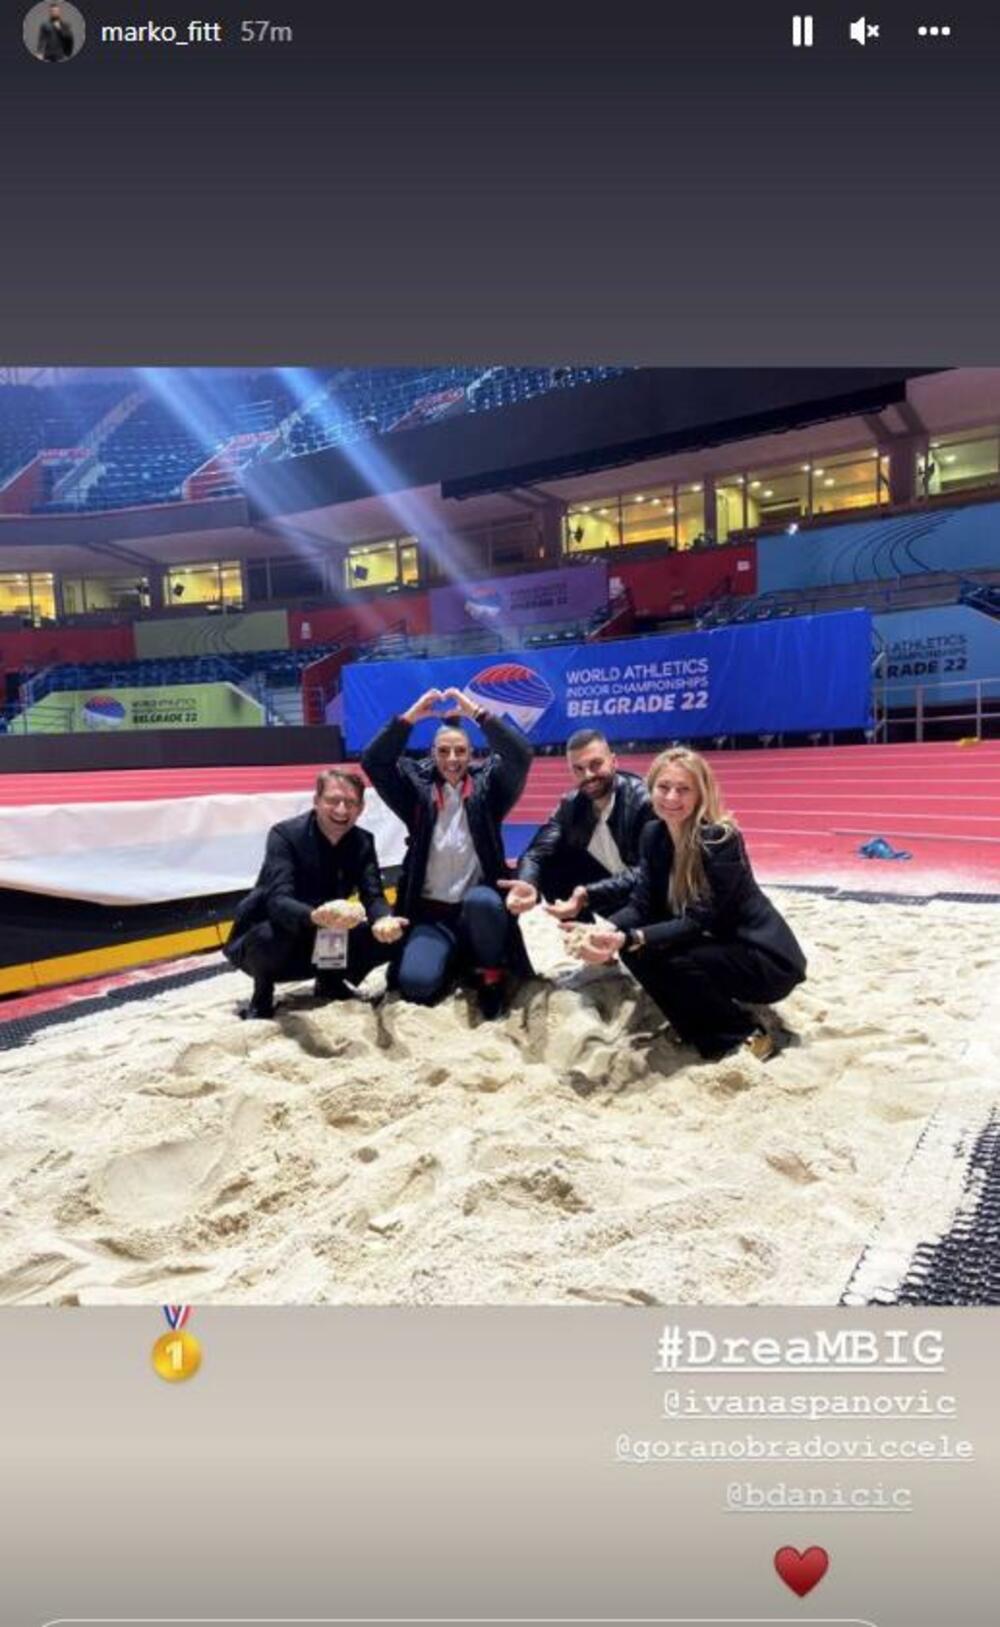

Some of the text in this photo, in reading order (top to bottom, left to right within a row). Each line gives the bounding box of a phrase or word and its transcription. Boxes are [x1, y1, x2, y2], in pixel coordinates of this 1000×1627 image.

[566, 657, 709, 684] WORLD ATHLETICS
[943, 656, 967, 672] 22
[566, 676, 709, 698] INDOOR CHAMPIONSHIPS
[566, 690, 709, 718] BELGRADE 22
